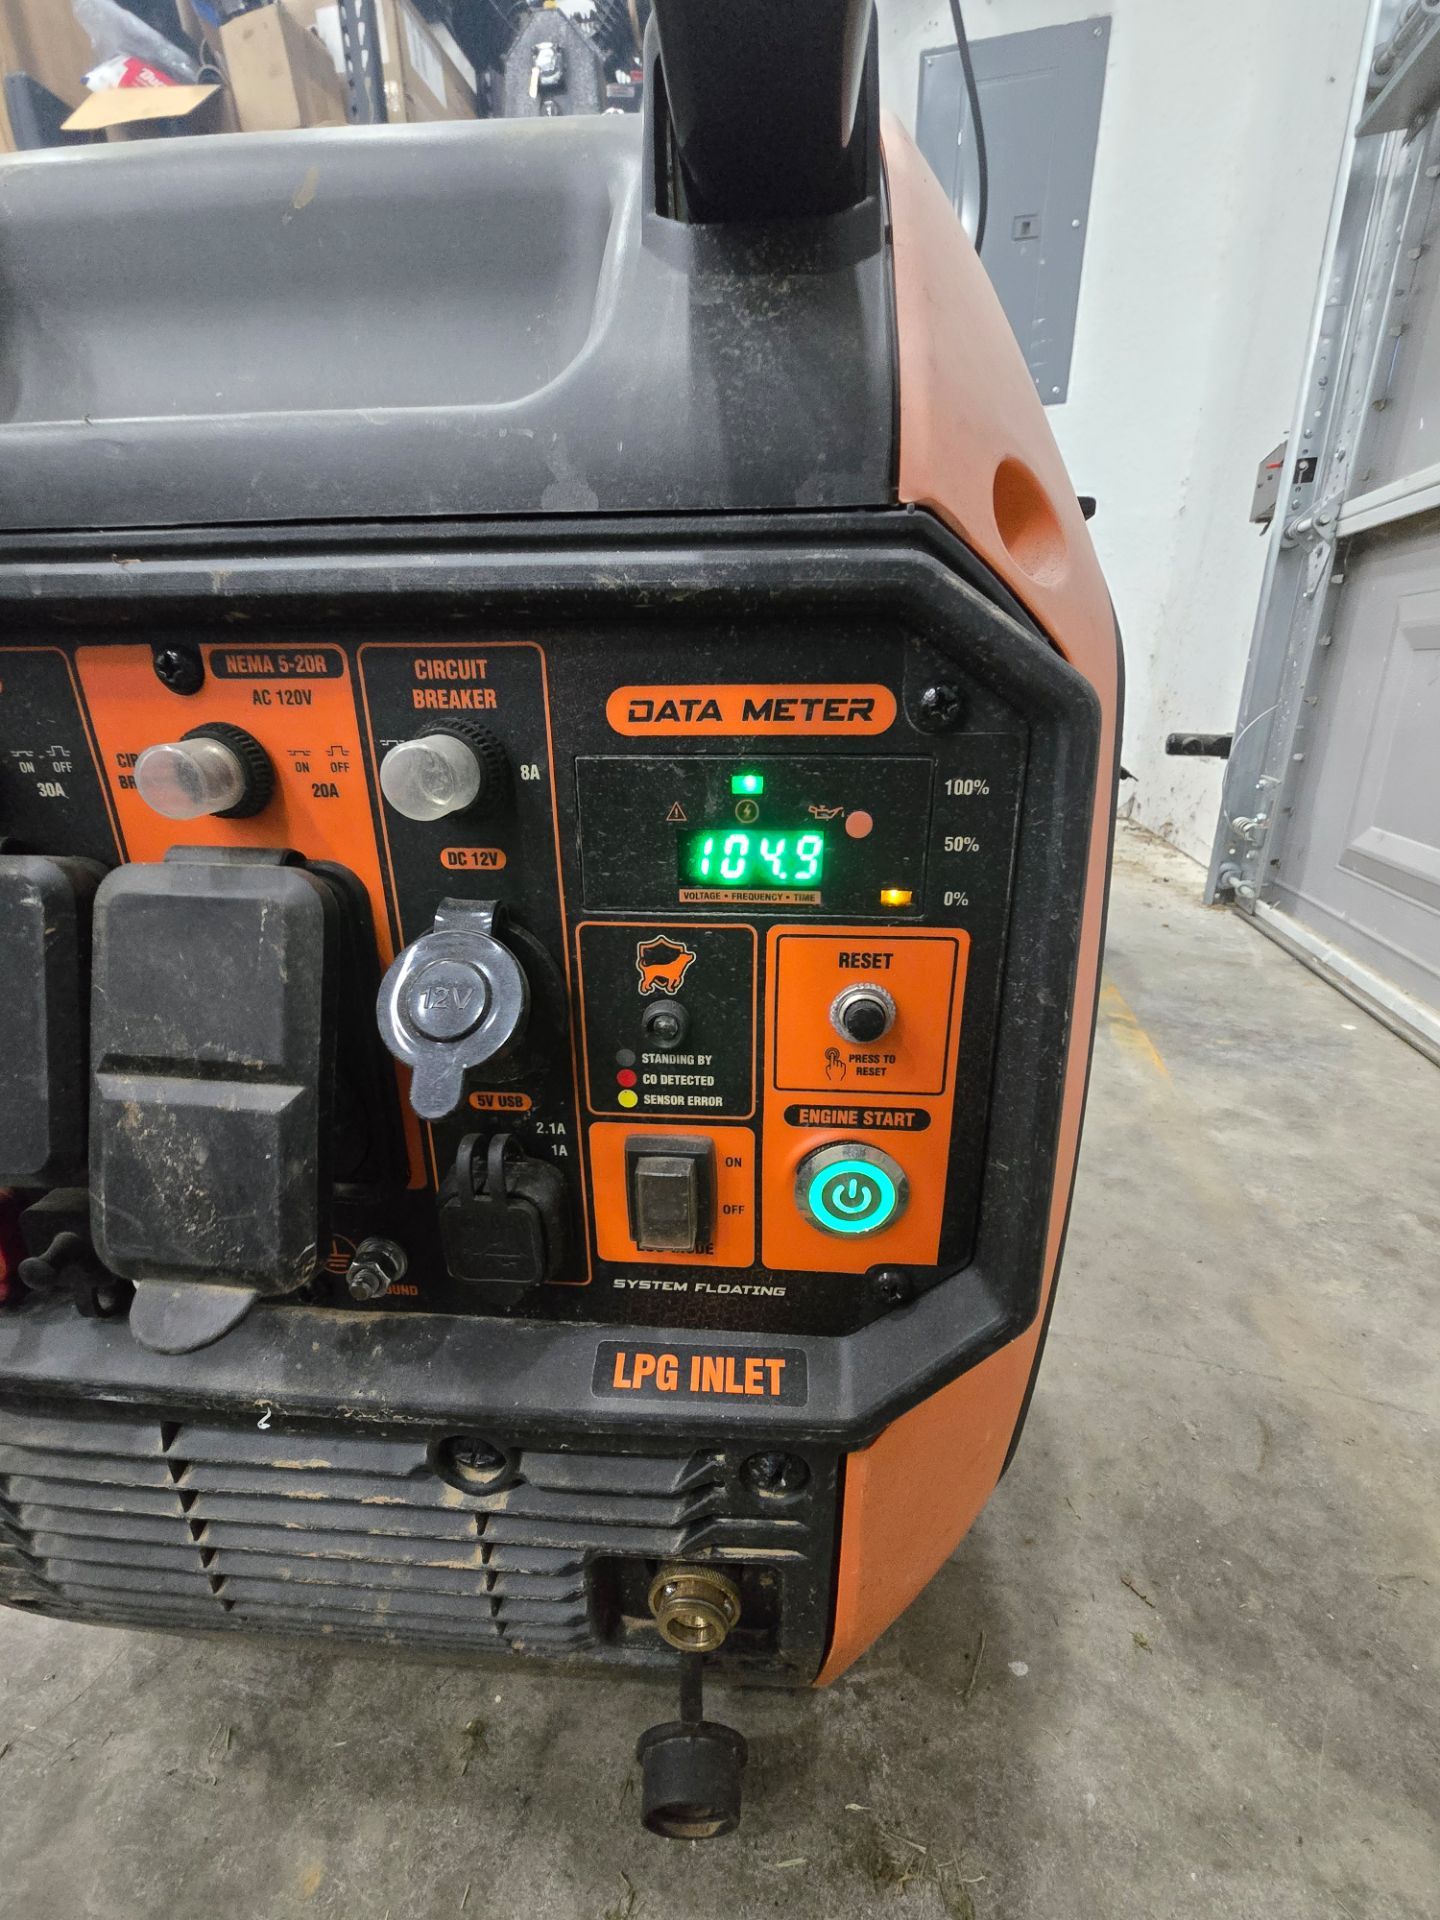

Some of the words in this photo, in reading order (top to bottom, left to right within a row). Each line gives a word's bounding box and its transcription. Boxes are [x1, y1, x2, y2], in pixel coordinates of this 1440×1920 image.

[226, 655, 275, 673] NEMA
[278, 655, 327, 673] 5-20R
[414, 659, 488, 679] CIRCUIT
[252, 689, 272, 705] AC
[277, 690, 312, 705] 120V
[412, 689, 497, 709] BREAKER
[628, 699, 723, 723] DATA
[741, 698, 876, 722] METER
[19, 761, 36, 774] ON
[52, 761, 73, 773] OFF
[294, 761, 310, 773] ON
[331, 762, 350, 773] OFF
[519, 764, 541, 781] 8A
[36, 782, 67, 797] 30A
[311, 783, 340, 798] 20A
[944, 779, 990, 795] 100%
[944, 836, 980, 852] 50%
[447, 852, 467, 866] DC
[473, 852, 498, 866] 12V
[700, 833, 824, 880] 104.9
[683, 891, 721, 900] VOLTAGE
[731, 892, 784, 901] FREQUENCY
[794, 893, 816, 902] TIME
[943, 891, 969, 906] 0%
[838, 952, 894, 970] RESET
[422, 986, 476, 1010] 12V
[641, 1053, 695, 1065] STANDING
[697, 1055, 713, 1066] BY
[848, 1054, 880, 1063] PRESS
[883, 1054, 896, 1064] TO
[855, 1067, 887, 1076] RESET
[642, 1074, 658, 1085] CO
[660, 1074, 715, 1086] DETECTED
[477, 1095, 494, 1107] 5V
[497, 1096, 524, 1108] USB
[643, 1094, 685, 1106] SENSOR
[687, 1096, 723, 1107] ERROR
[799, 1108, 859, 1125] ENGINE
[862, 1111, 916, 1127] START
[535, 1121, 567, 1136] 2.1A
[551, 1144, 569, 1157] 1A
[725, 1157, 743, 1168] ON
[722, 1204, 746, 1215] OFF
[613, 1278, 688, 1292] SYSTEM
[694, 1282, 787, 1297] FLOATING
[612, 1352, 679, 1391] LPG
[689, 1355, 786, 1396] INLET
